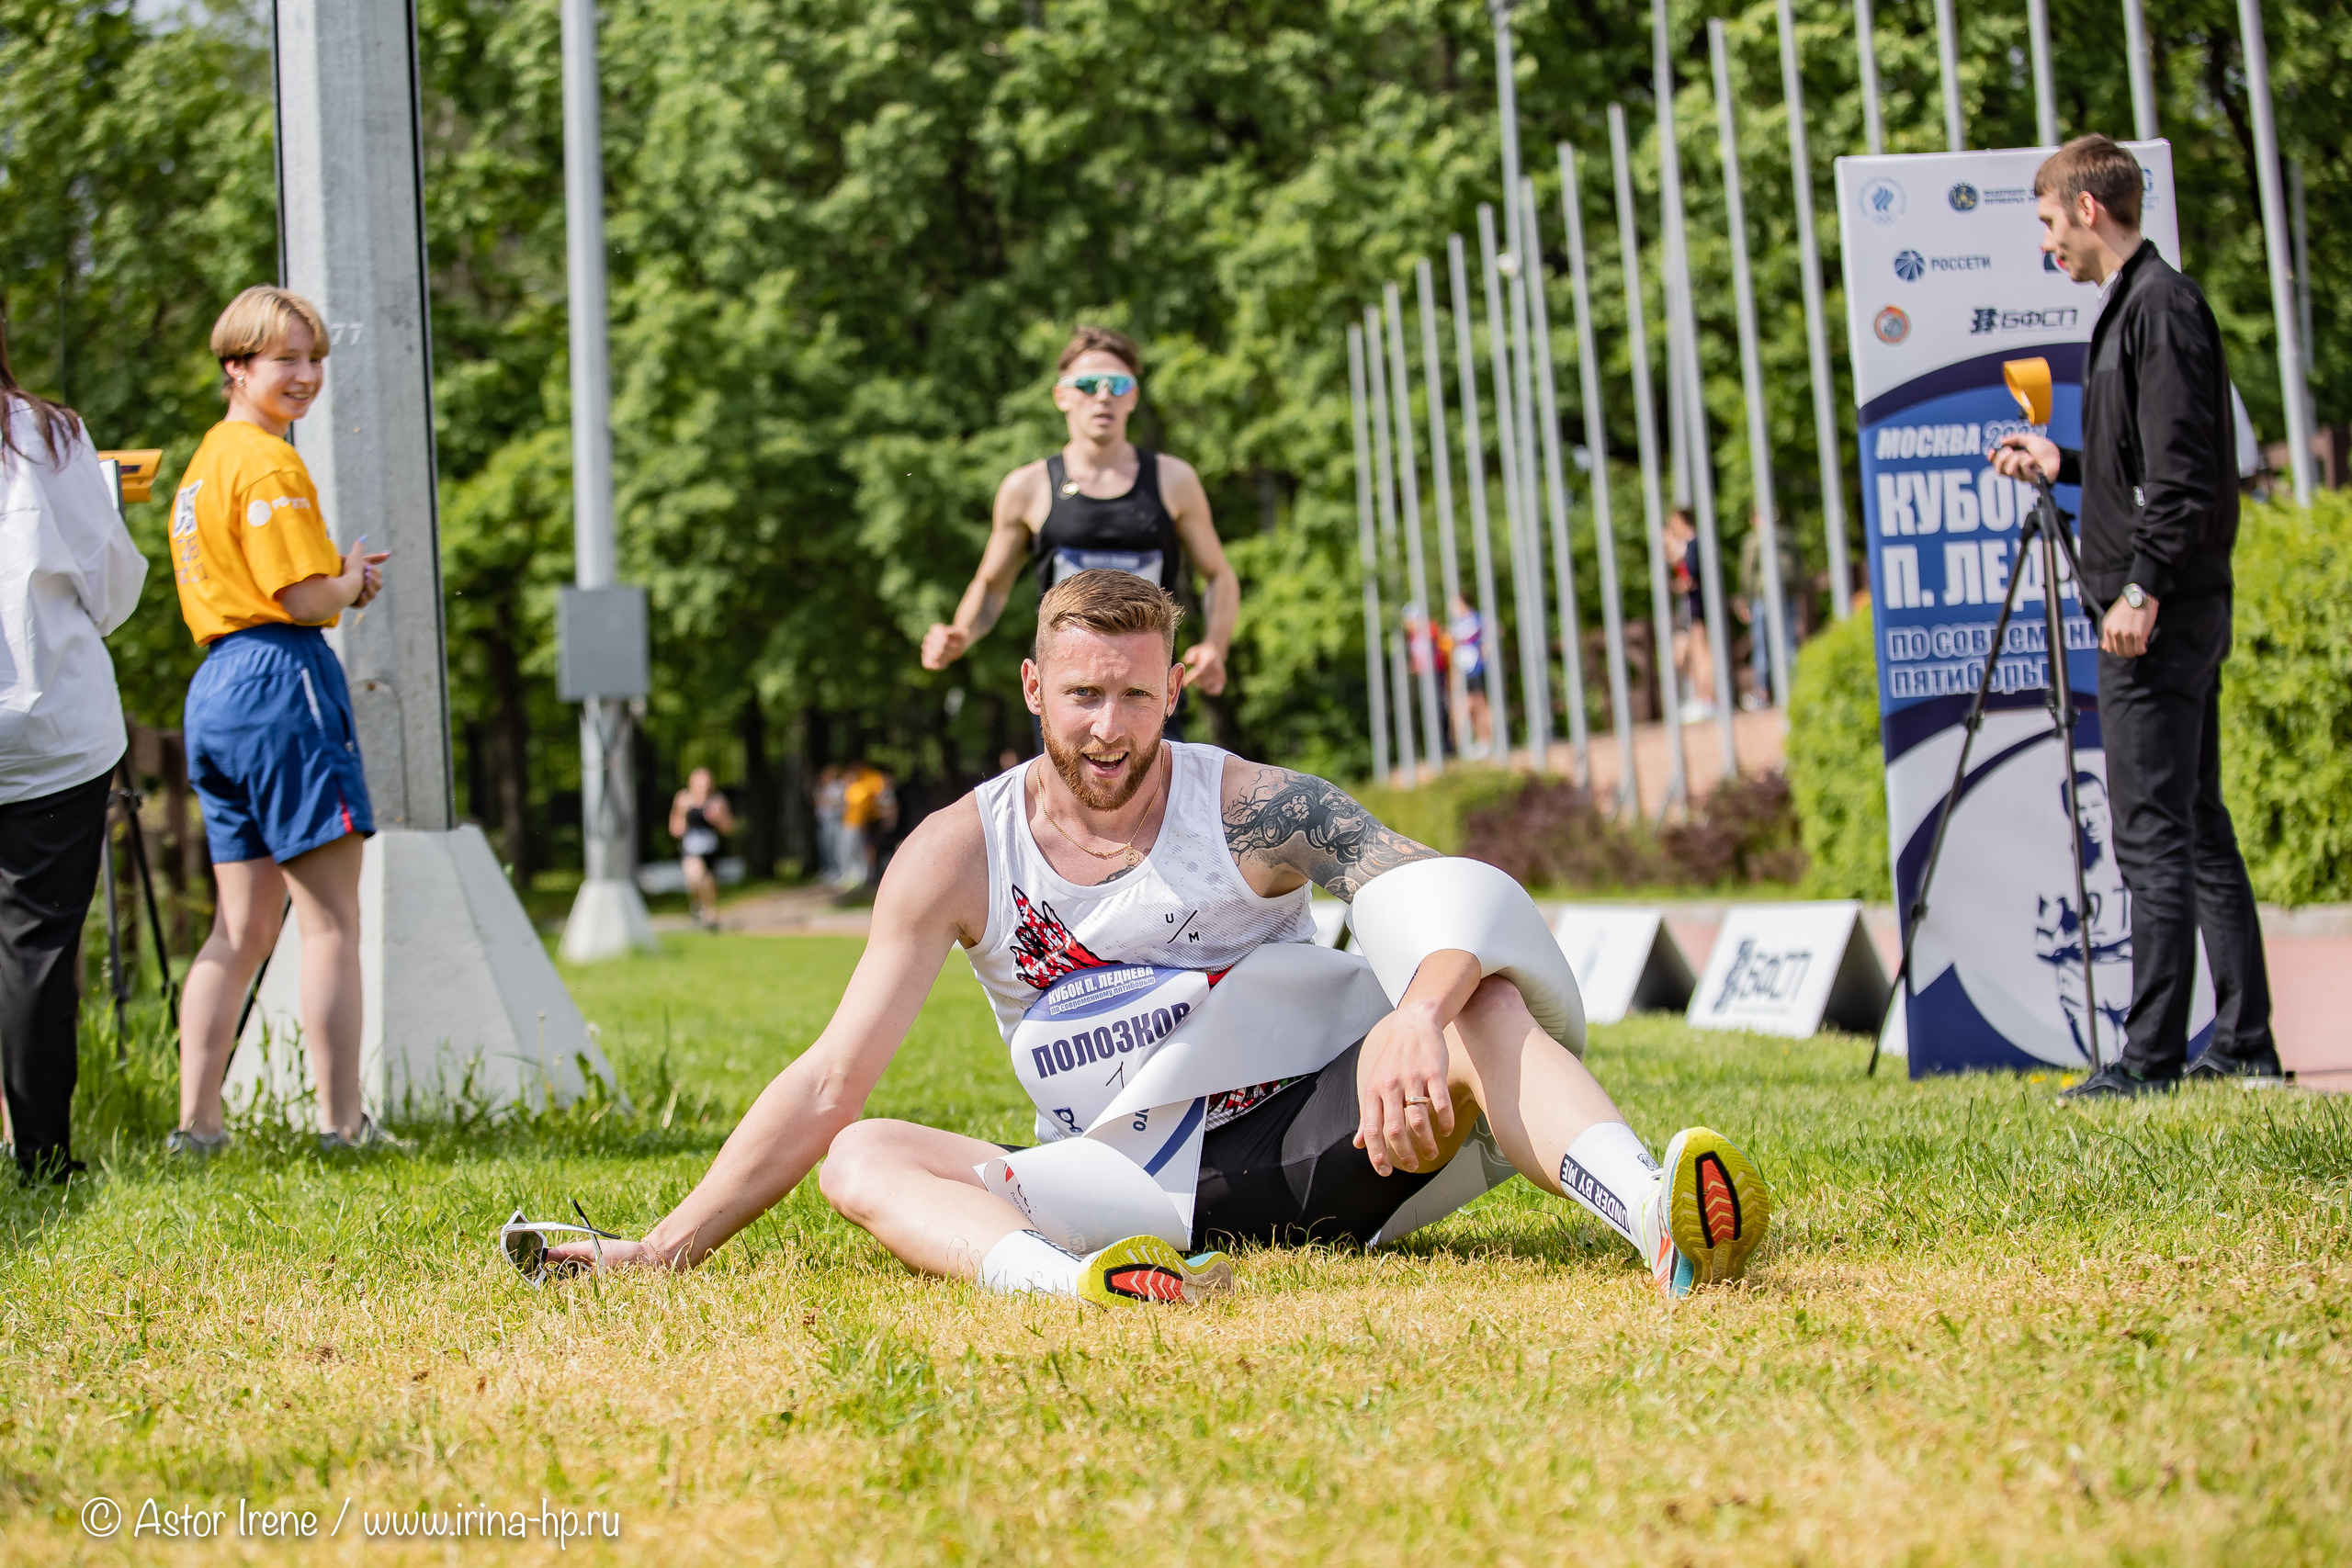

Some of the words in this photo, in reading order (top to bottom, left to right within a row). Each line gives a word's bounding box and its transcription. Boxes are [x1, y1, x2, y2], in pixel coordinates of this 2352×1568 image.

[1931, 255, 1992, 271] РОССЕТИ
[1876, 423, 1981, 459] МОСКВА
[1882, 543, 1935, 610] П.
[1165, 912, 1174, 924] U
[1188, 931, 1200, 943] M
[1047, 980, 1085, 1005] КУБОК
[1086, 978, 1098, 993] П.
[1098, 966, 1154, 989] ЛЕДНЕВА
[1050, 1005, 1061, 1016] по
[1060, 989, 1114, 1012] современному
[1114, 976, 1156, 996] пятиборью
[1031, 1001, 1192, 1080] ПОЛОЗКОВ
[1561, 1158, 1579, 1188] ME
[1577, 1173, 1595, 1201] BY
[1595, 1183, 1630, 1230] UNDER
